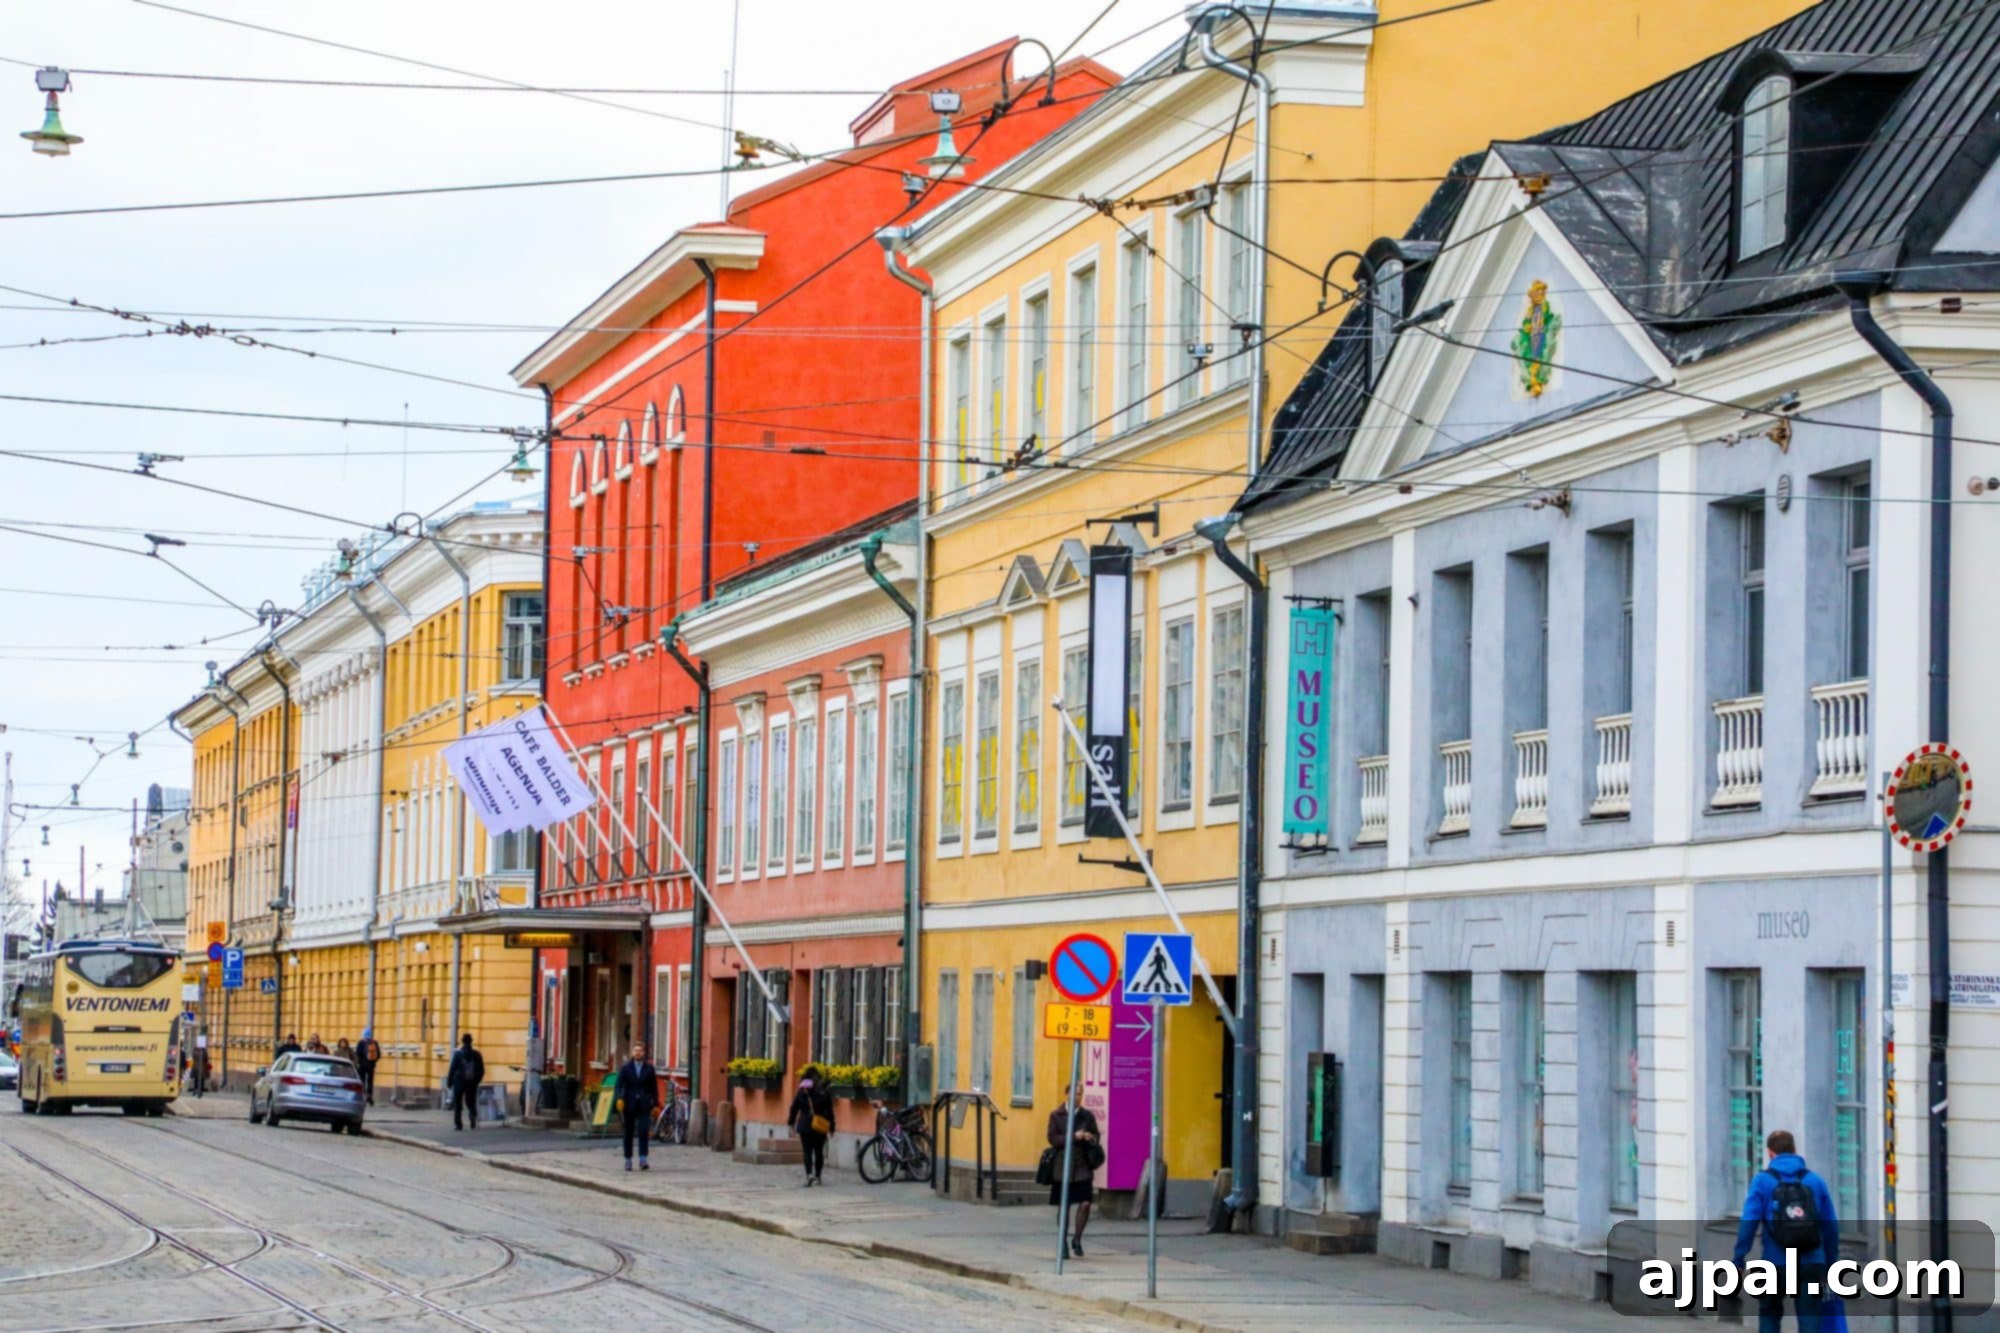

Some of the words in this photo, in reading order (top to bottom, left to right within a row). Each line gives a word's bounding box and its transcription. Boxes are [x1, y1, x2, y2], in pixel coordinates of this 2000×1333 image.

[1293, 669, 1322, 822] MUSEO
[514, 720, 541, 755] CAFÉ
[536, 755, 572, 807] BALDER
[1757, 910, 1810, 939] museo
[226, 950, 241, 968] P
[66, 997, 171, 1012] VENTONIEMI
[1064, 1006, 1070, 1019] 7
[1083, 1007, 1095, 1021] 18
[1057, 1022, 1069, 1035] (9
[1082, 1023, 1099, 1037] 15)
[74, 1043, 158, 1053] www.ventoniemi.fi
